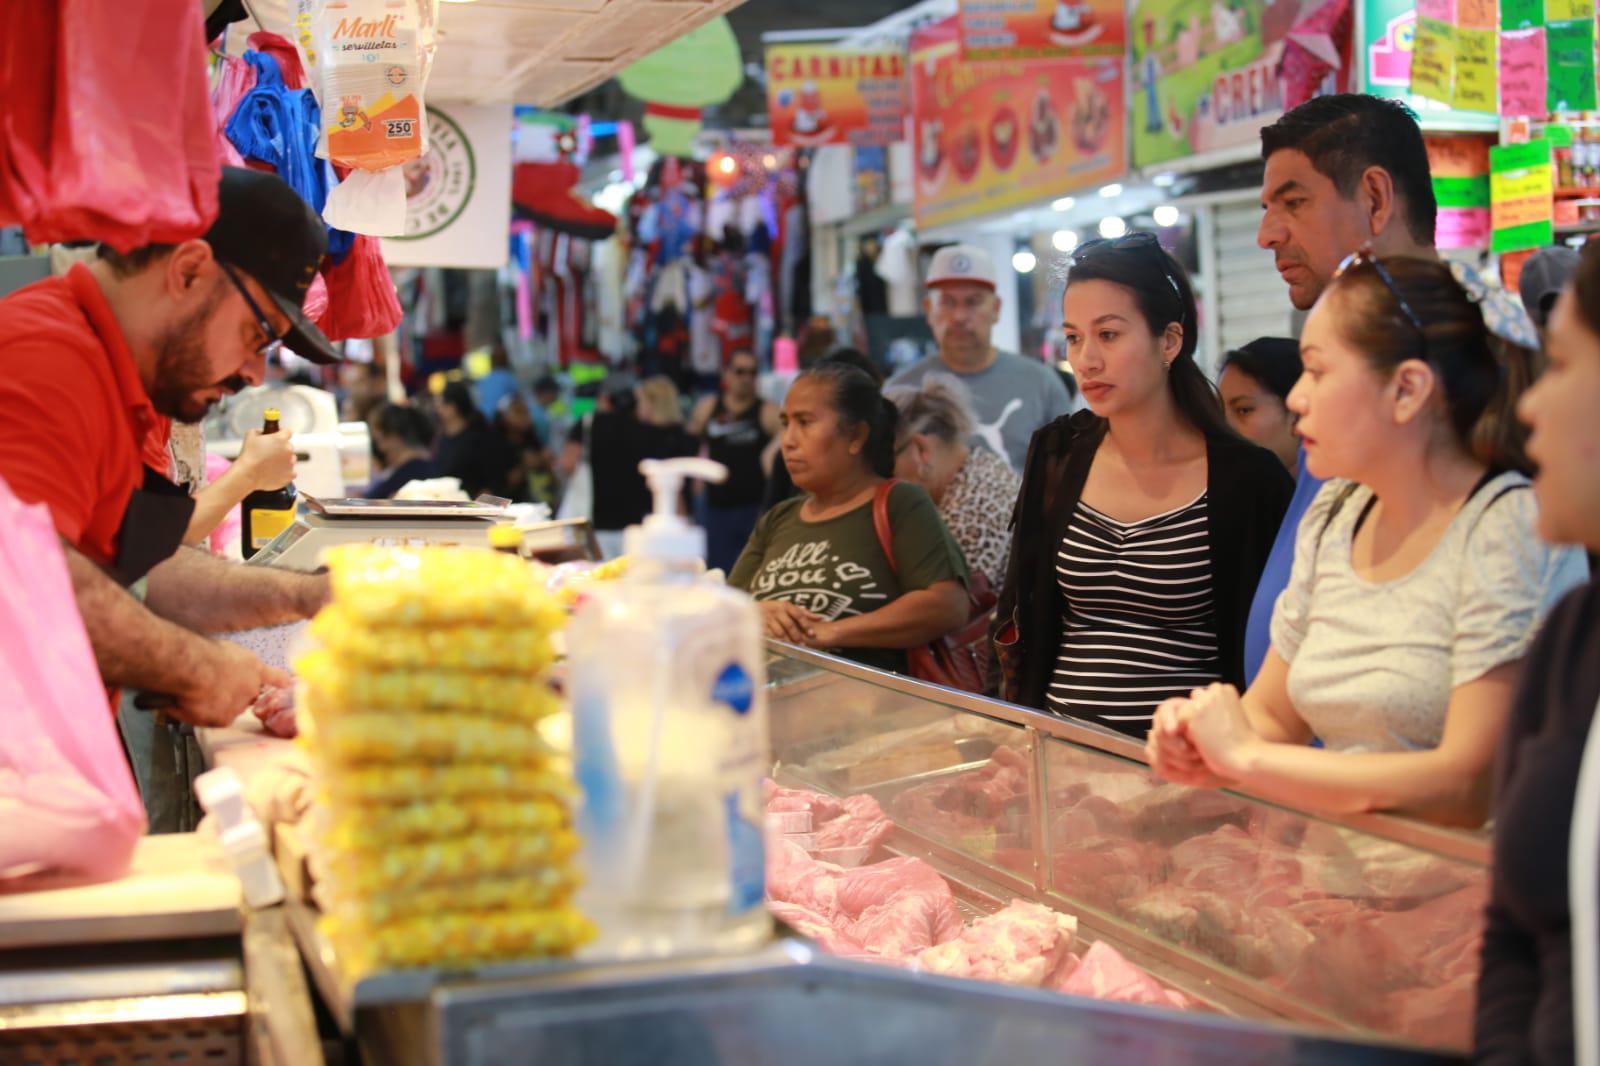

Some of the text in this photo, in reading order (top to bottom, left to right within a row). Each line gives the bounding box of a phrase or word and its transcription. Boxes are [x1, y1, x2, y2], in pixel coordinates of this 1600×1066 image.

[333, 14, 398, 40] Marli
[342, 40, 398, 51] servilletas
[770, 53, 904, 80] CARNITAS
[388, 122, 412, 134] 250
[766, 540, 830, 572] All
[757, 567, 827, 593] you
